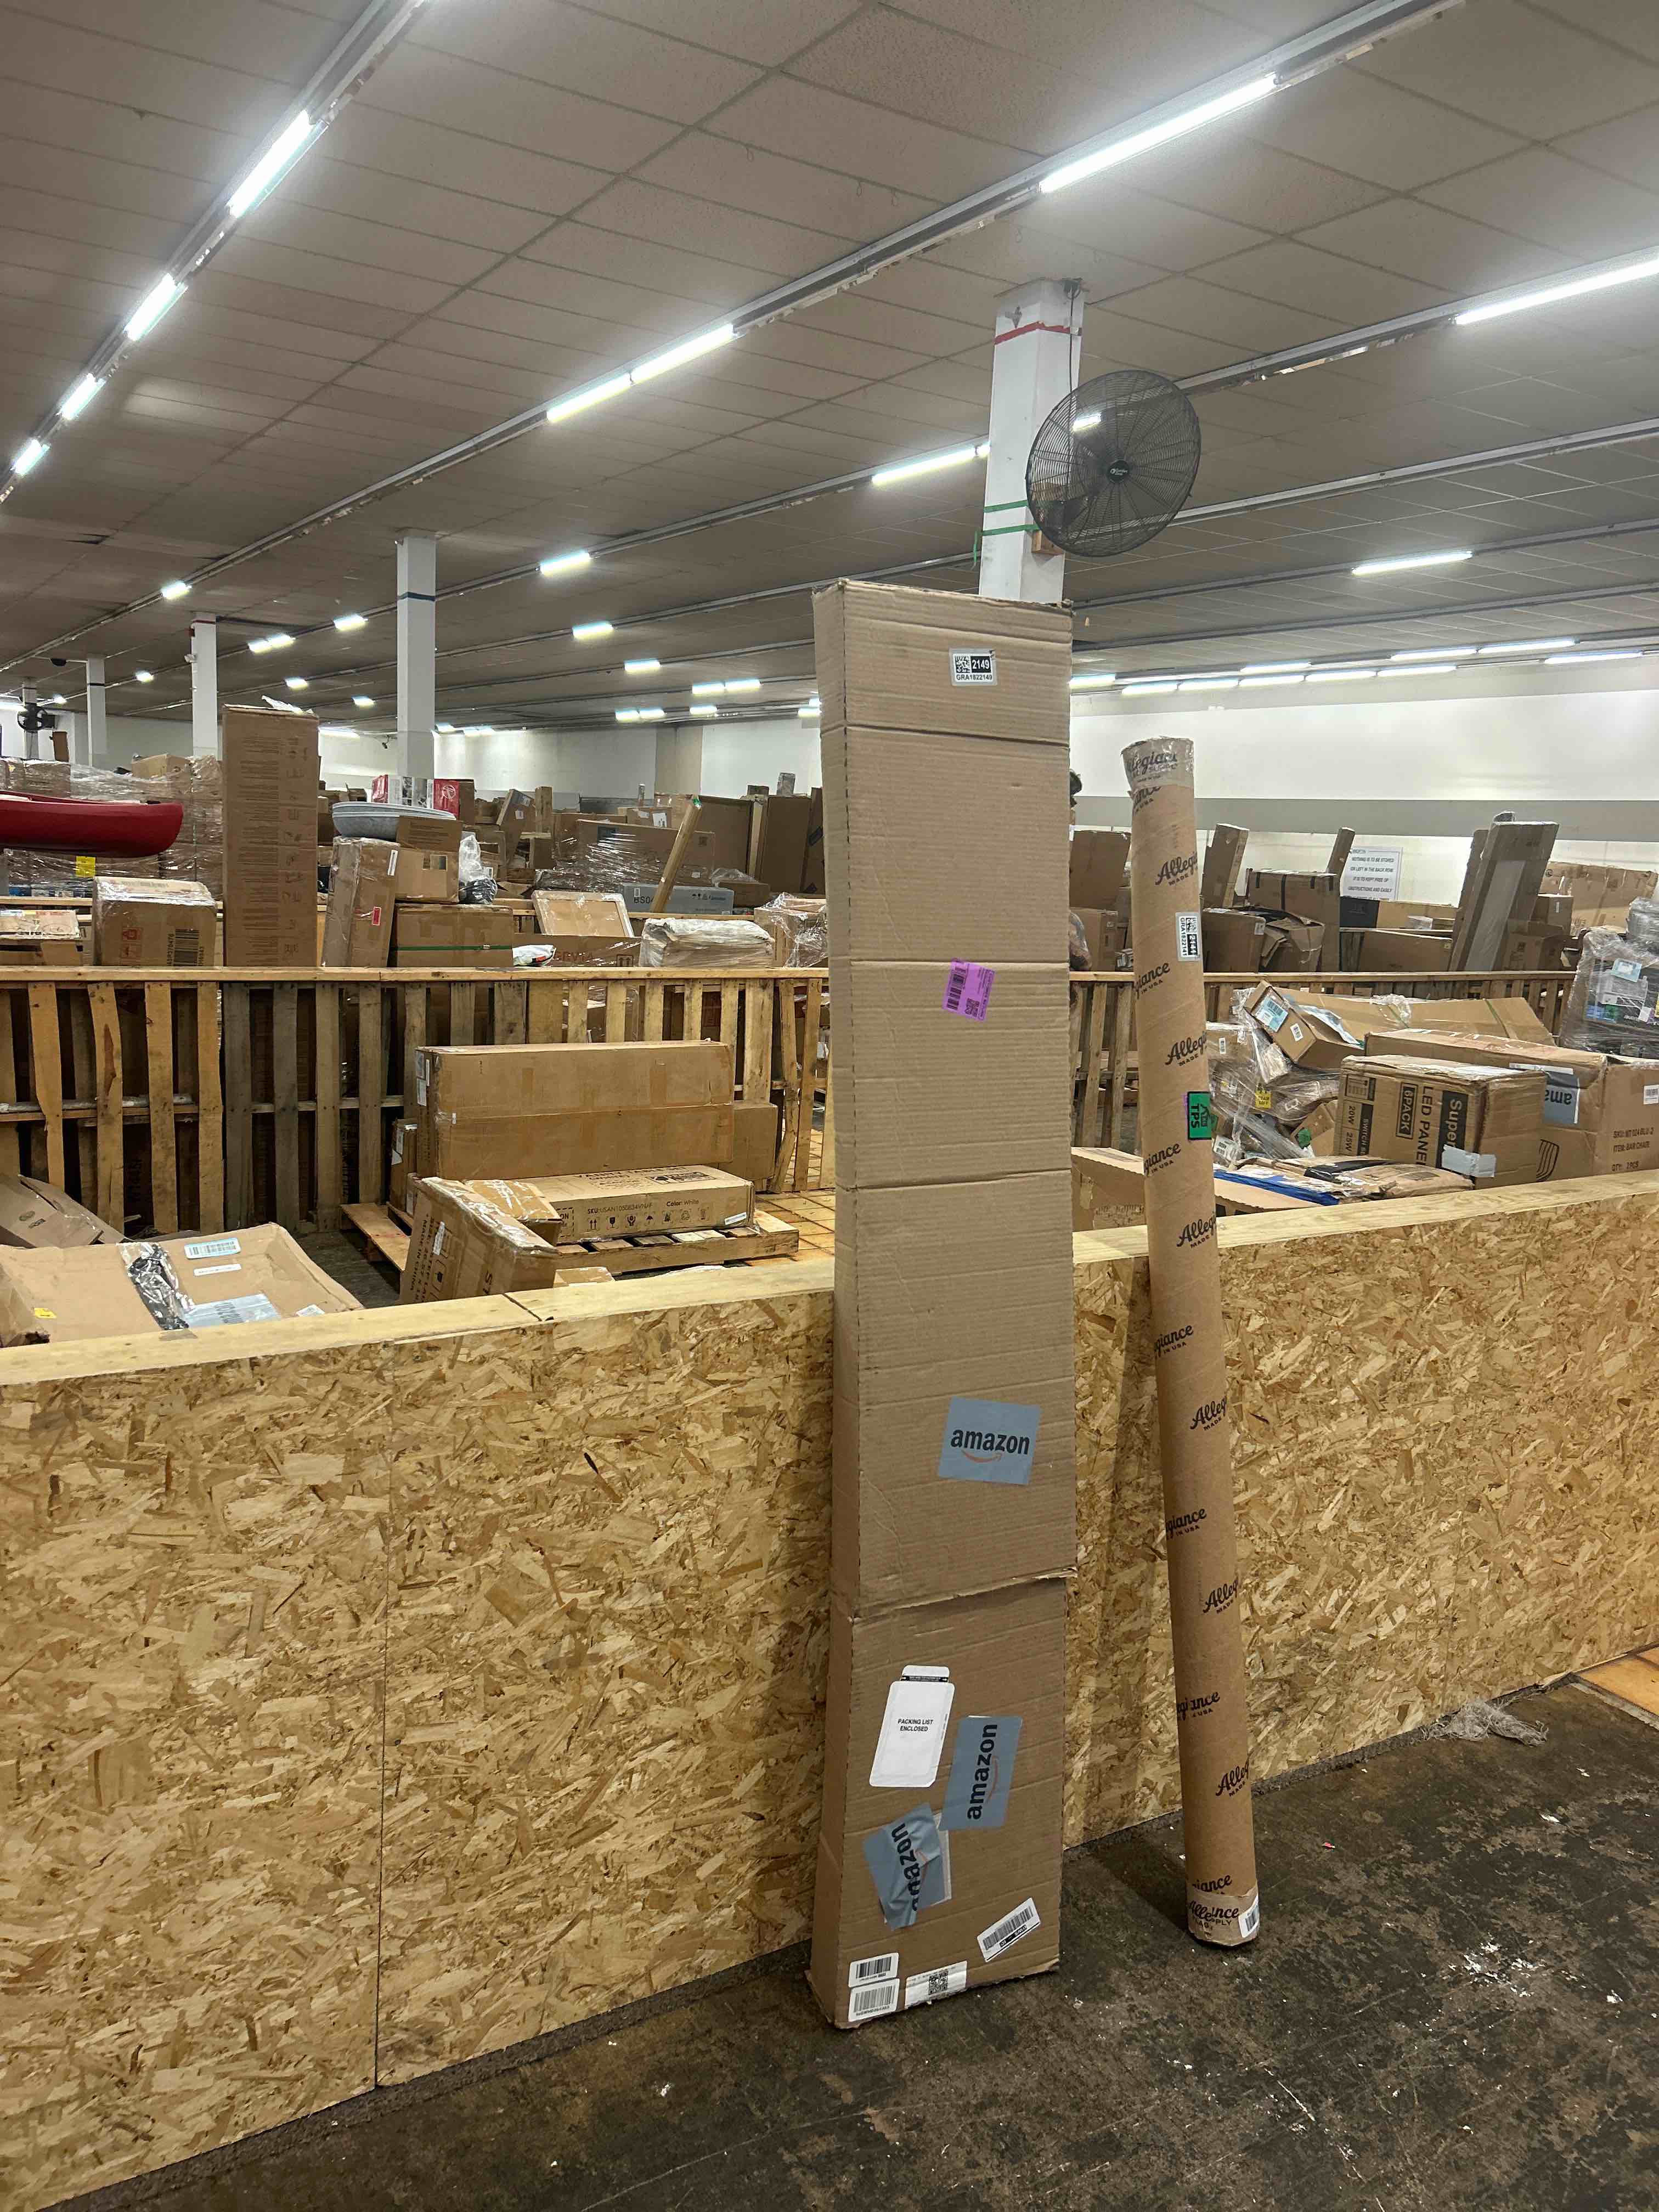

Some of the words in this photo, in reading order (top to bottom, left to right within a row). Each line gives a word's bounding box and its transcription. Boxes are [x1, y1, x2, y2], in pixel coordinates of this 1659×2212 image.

[972, 659, 990, 669] 2149
[1169, 873, 1189, 886] MADE
[1148, 979, 1164, 991] USA
[1179, 1053, 1199, 1066] MADE
[1420, 1086, 1434, 1116] LED
[1190, 1103, 1200, 1128] TPS
[1348, 1105, 1356, 1125] 20W
[1401, 1089, 1412, 1131] 6PACK
[1159, 1159, 1175, 1169] USA
[1190, 1235, 1210, 1249] MADE
[416, 1249, 422, 1259] IN
[1171, 1341, 1187, 1351] USA
[1203, 1417, 1222, 1432] MADE
[950, 1429, 1030, 1455] amazon
[1184, 1525, 1200, 1533] USA
[1198, 1708, 1214, 1717] USA
[967, 1724, 998, 1820] amazon
